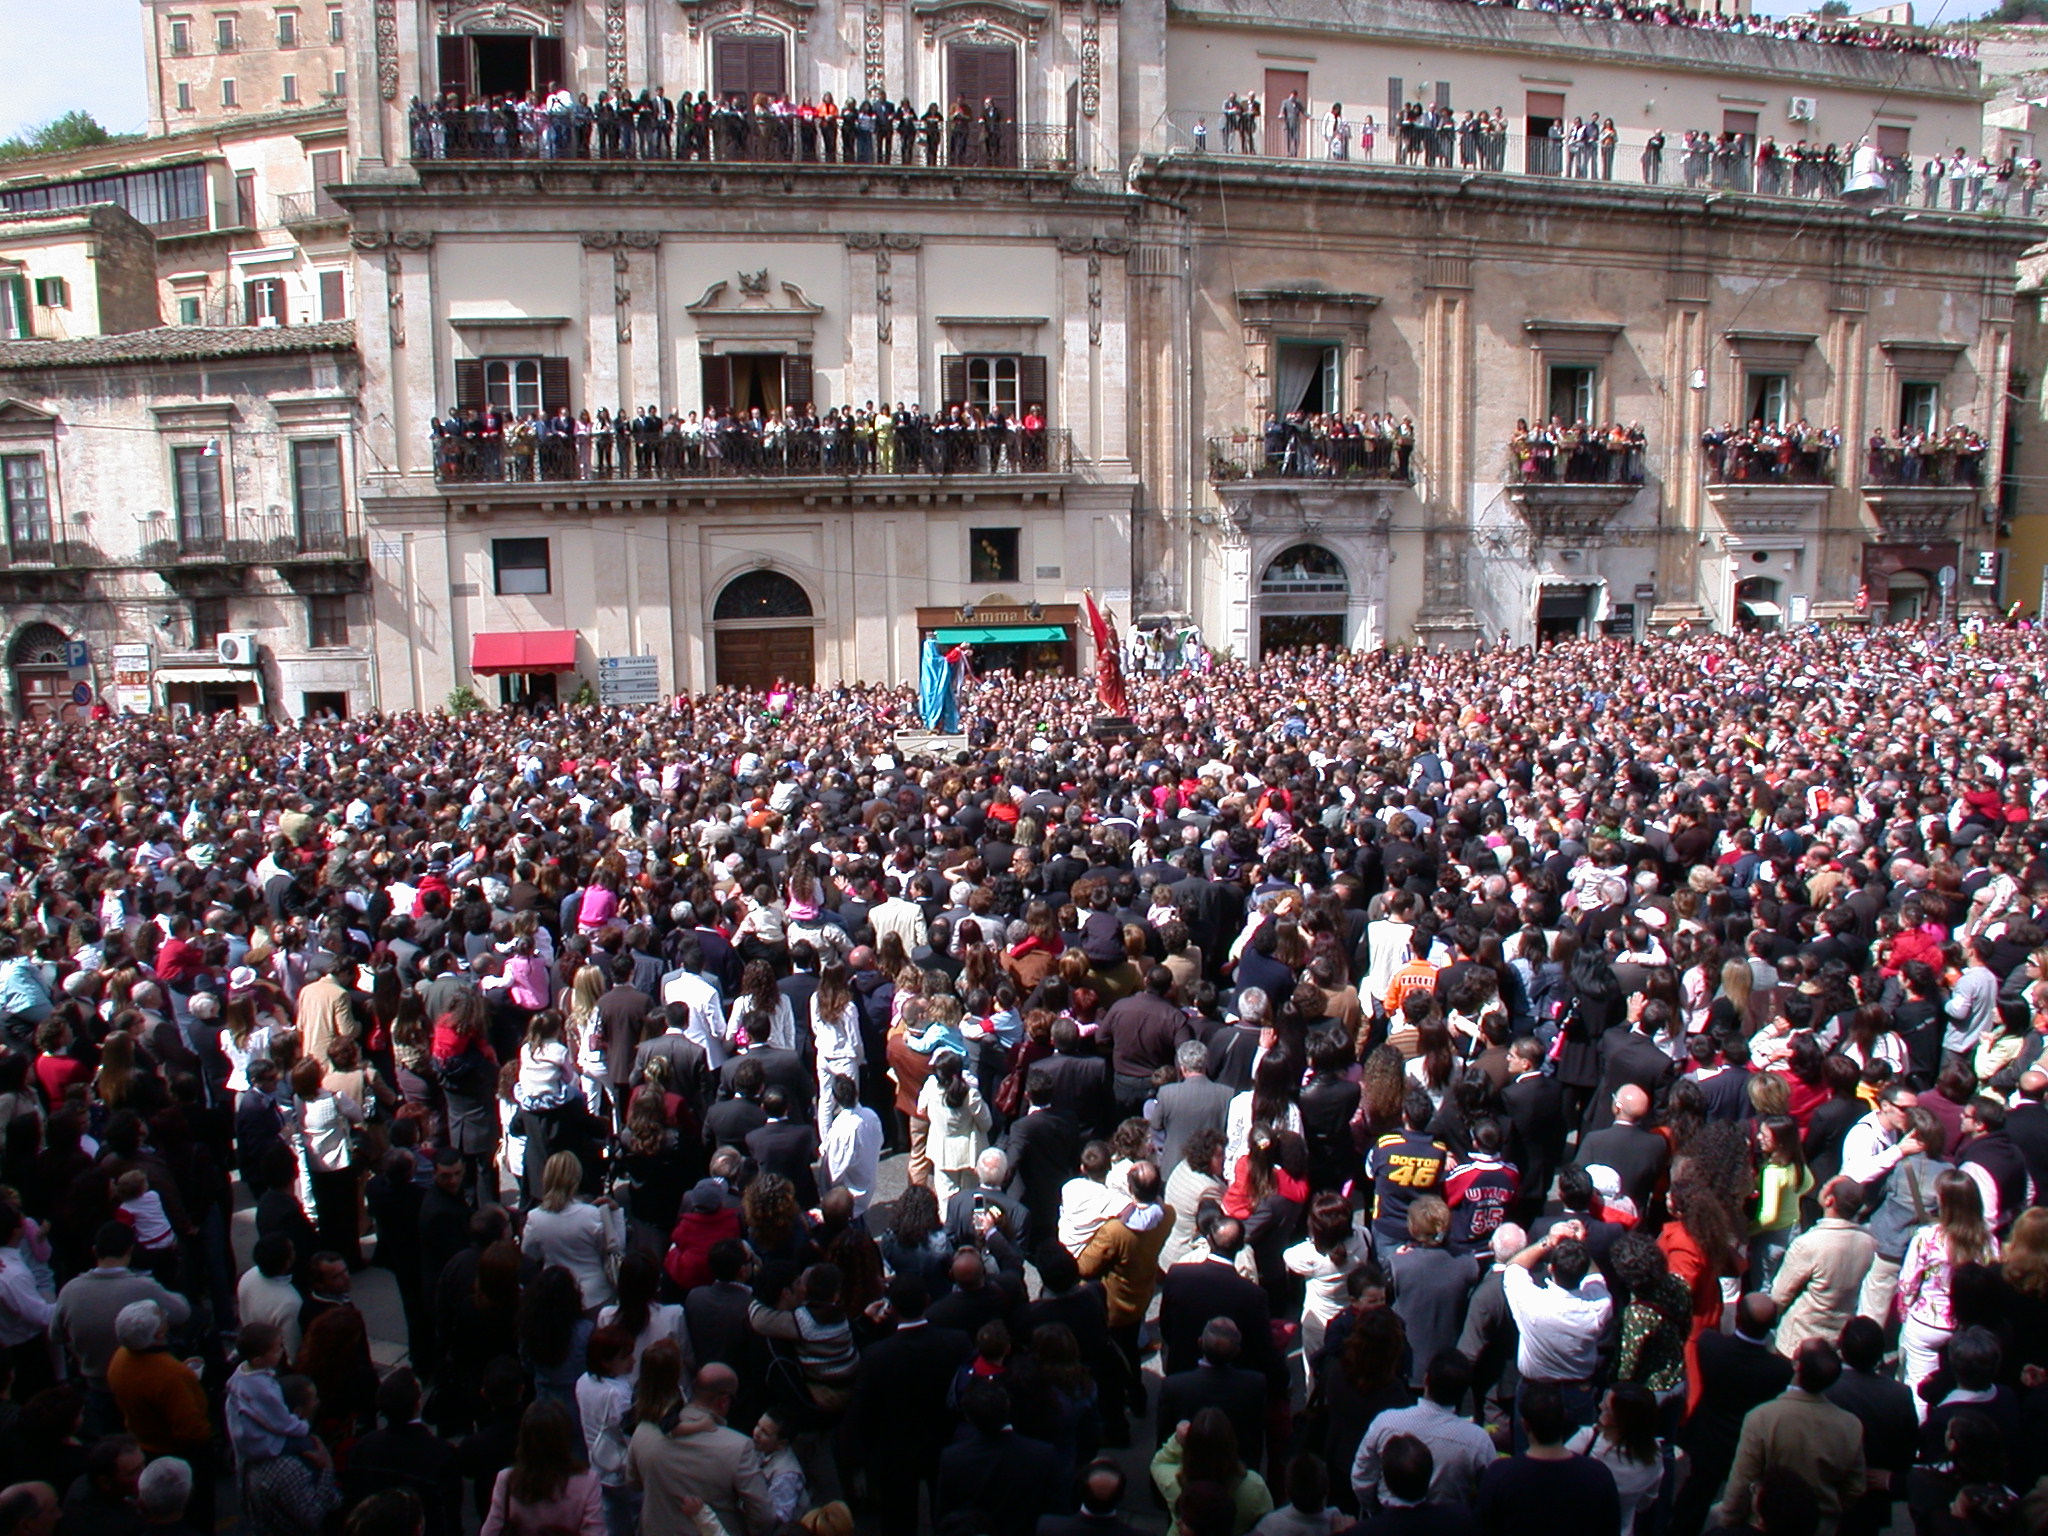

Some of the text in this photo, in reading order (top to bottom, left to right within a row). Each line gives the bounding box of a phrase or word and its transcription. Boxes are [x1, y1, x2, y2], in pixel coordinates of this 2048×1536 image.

[954, 610, 1018, 623] Mamma
[71, 644, 84, 665] P
[1389, 1155, 1440, 1168] DOCTOR
[1388, 1167, 1436, 1187] 46
[1470, 1207, 1504, 1234] 55
